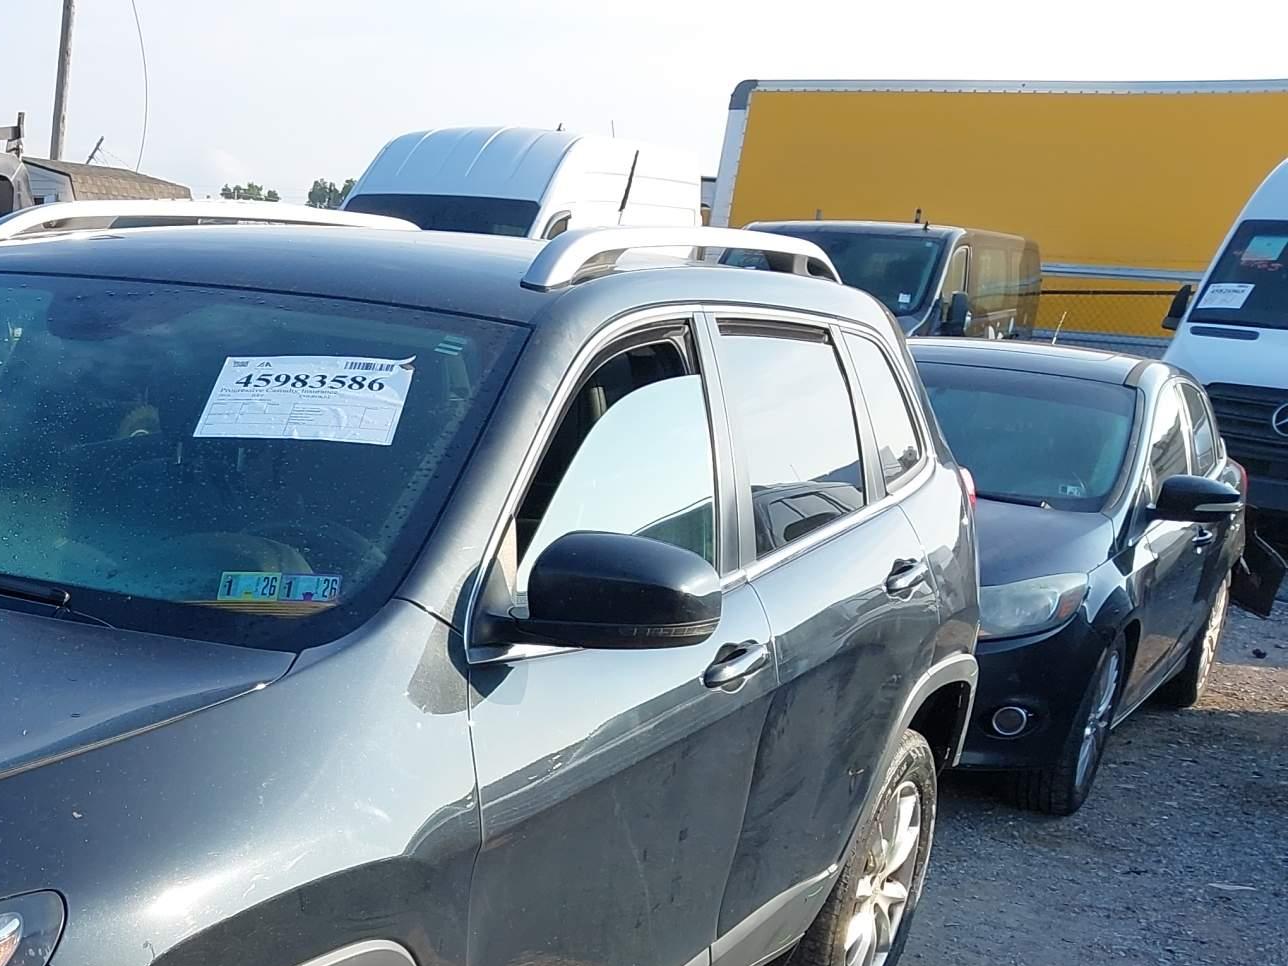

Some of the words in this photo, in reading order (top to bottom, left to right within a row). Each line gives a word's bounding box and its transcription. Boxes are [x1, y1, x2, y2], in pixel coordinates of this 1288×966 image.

[235, 373, 386, 392] 45983586
[261, 576, 278, 597] 26
[321, 578, 338, 599] 26
